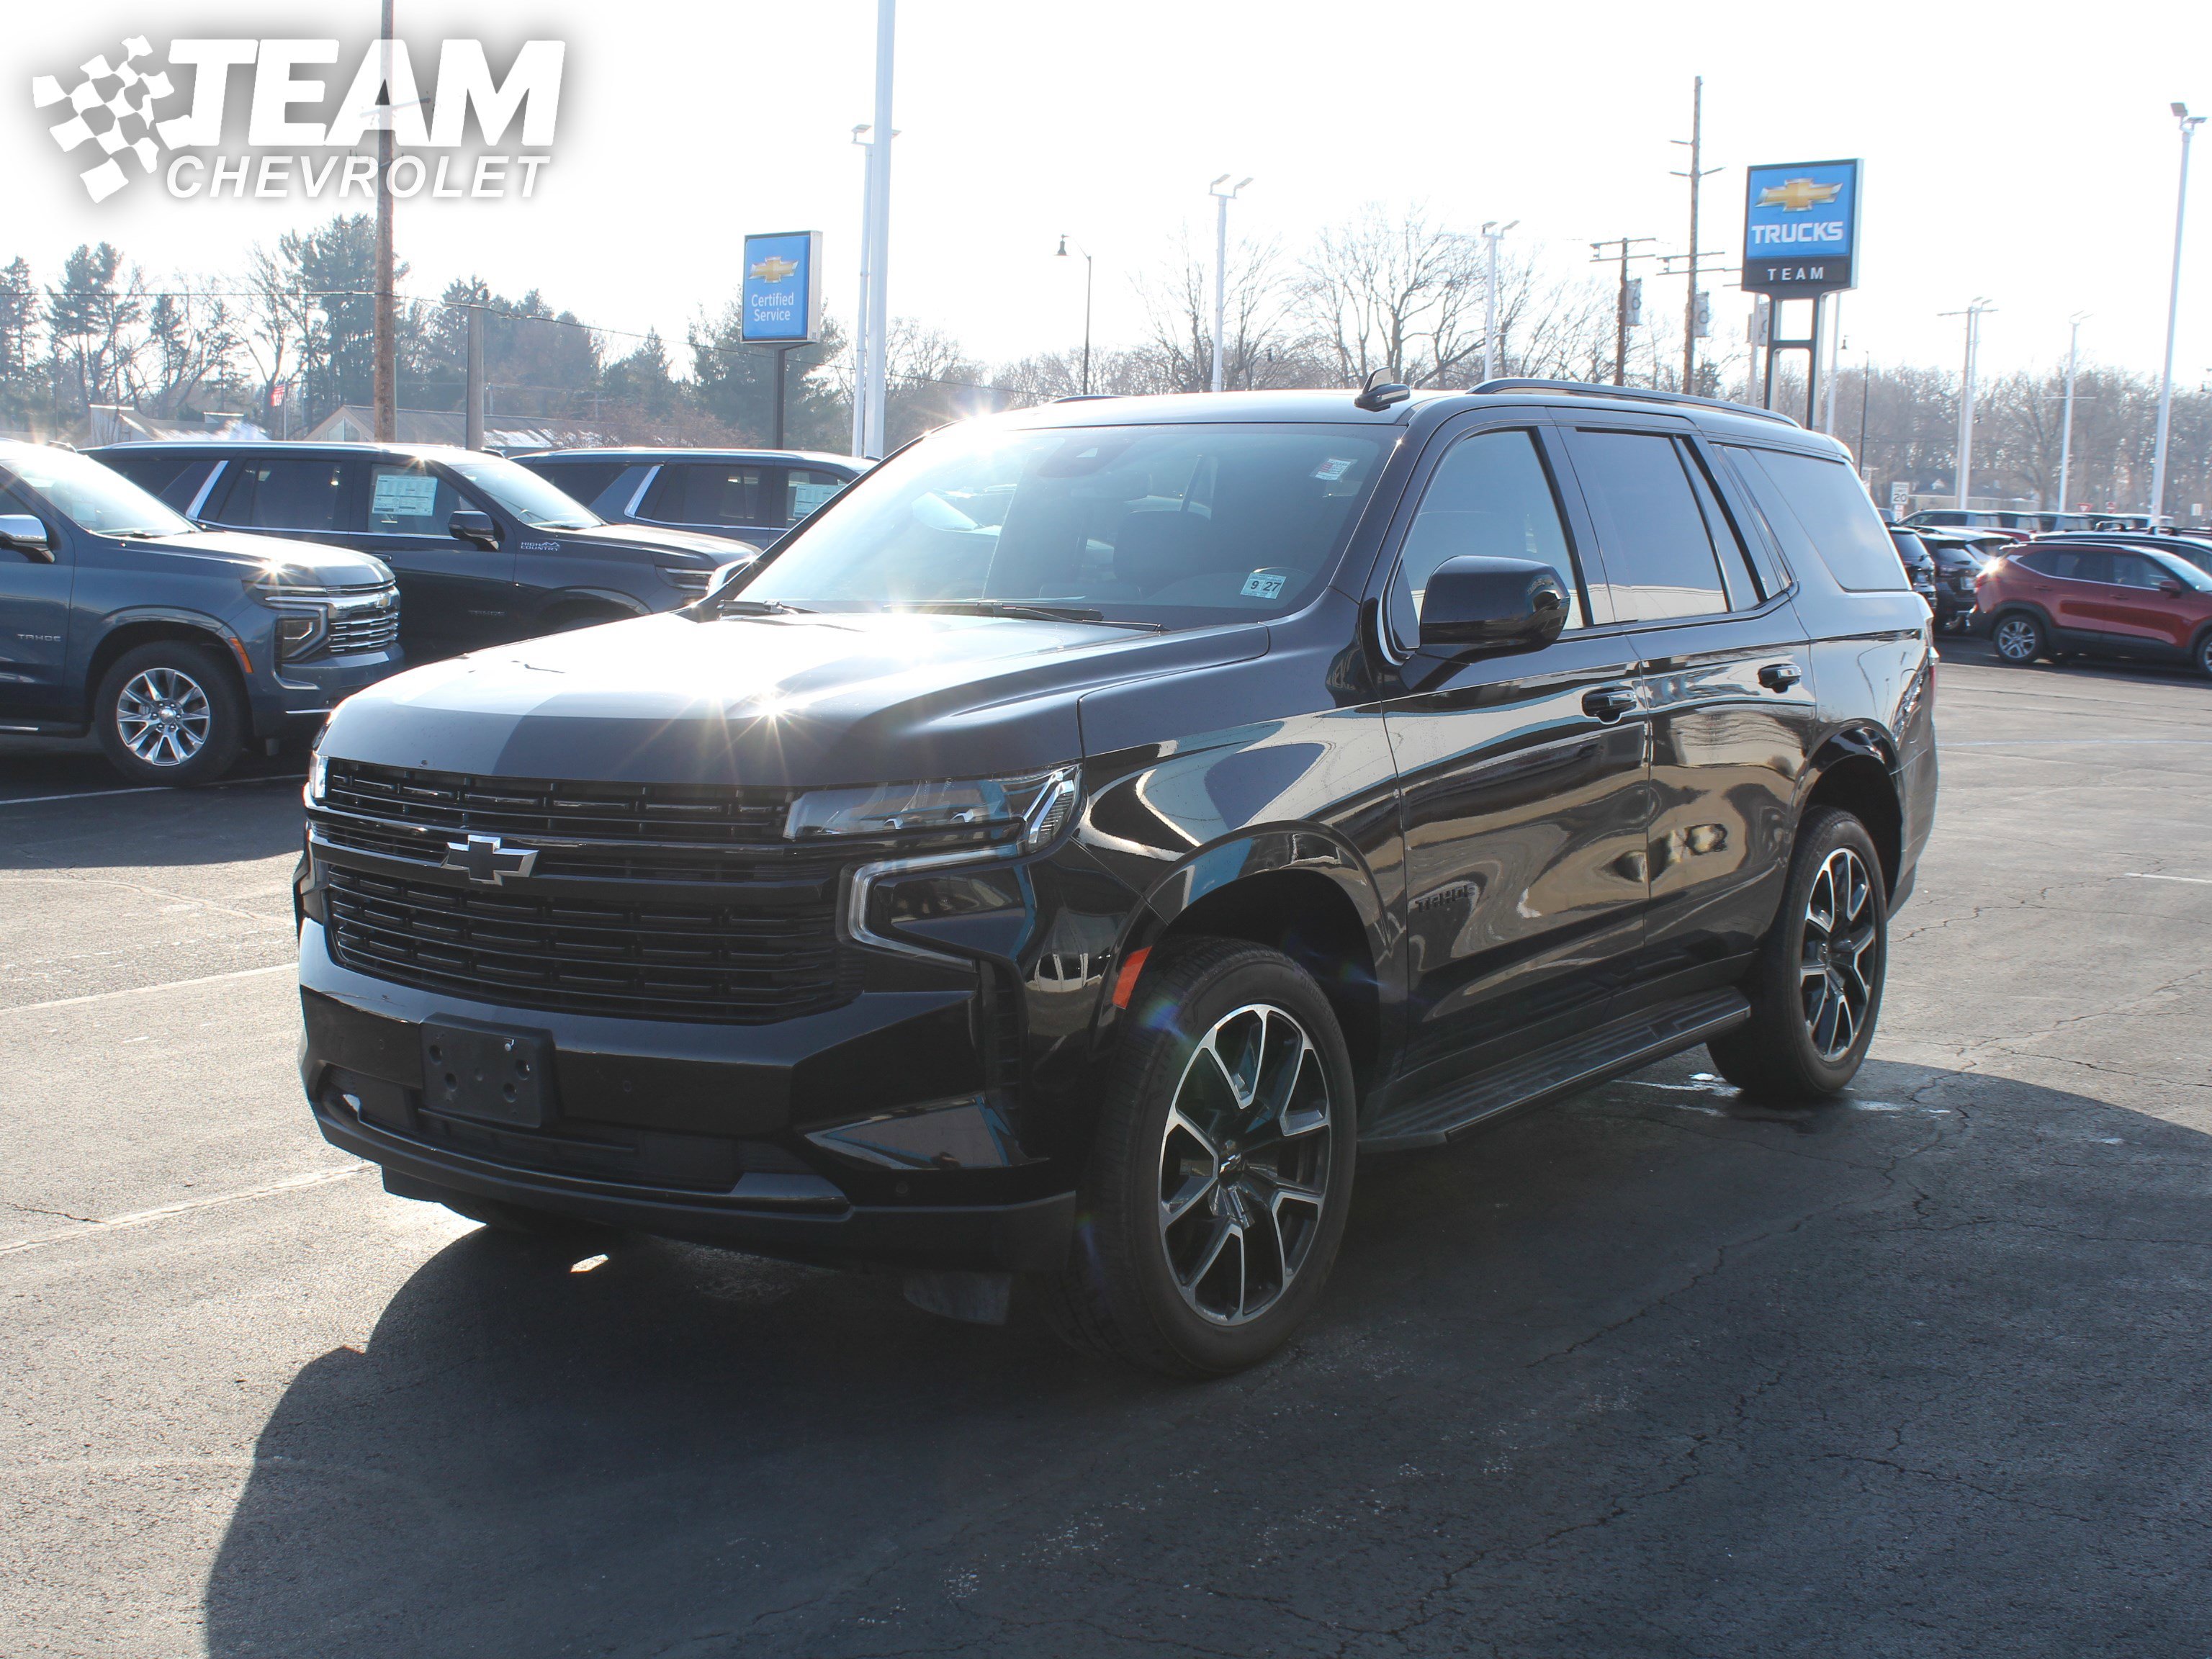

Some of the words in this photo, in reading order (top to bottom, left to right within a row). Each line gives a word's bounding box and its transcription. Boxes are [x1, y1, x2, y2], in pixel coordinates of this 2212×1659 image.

[1751, 221, 1844, 244] TRUCKS
[1767, 266, 1824, 282] TEAM
[751, 292, 794, 307] Certified
[754, 308, 791, 322] Service
[1893, 493, 1907, 503] 20
[1251, 580, 1259, 590] 9
[1262, 581, 1281, 592] 27
[1415, 884, 1476, 913] TAHOE
